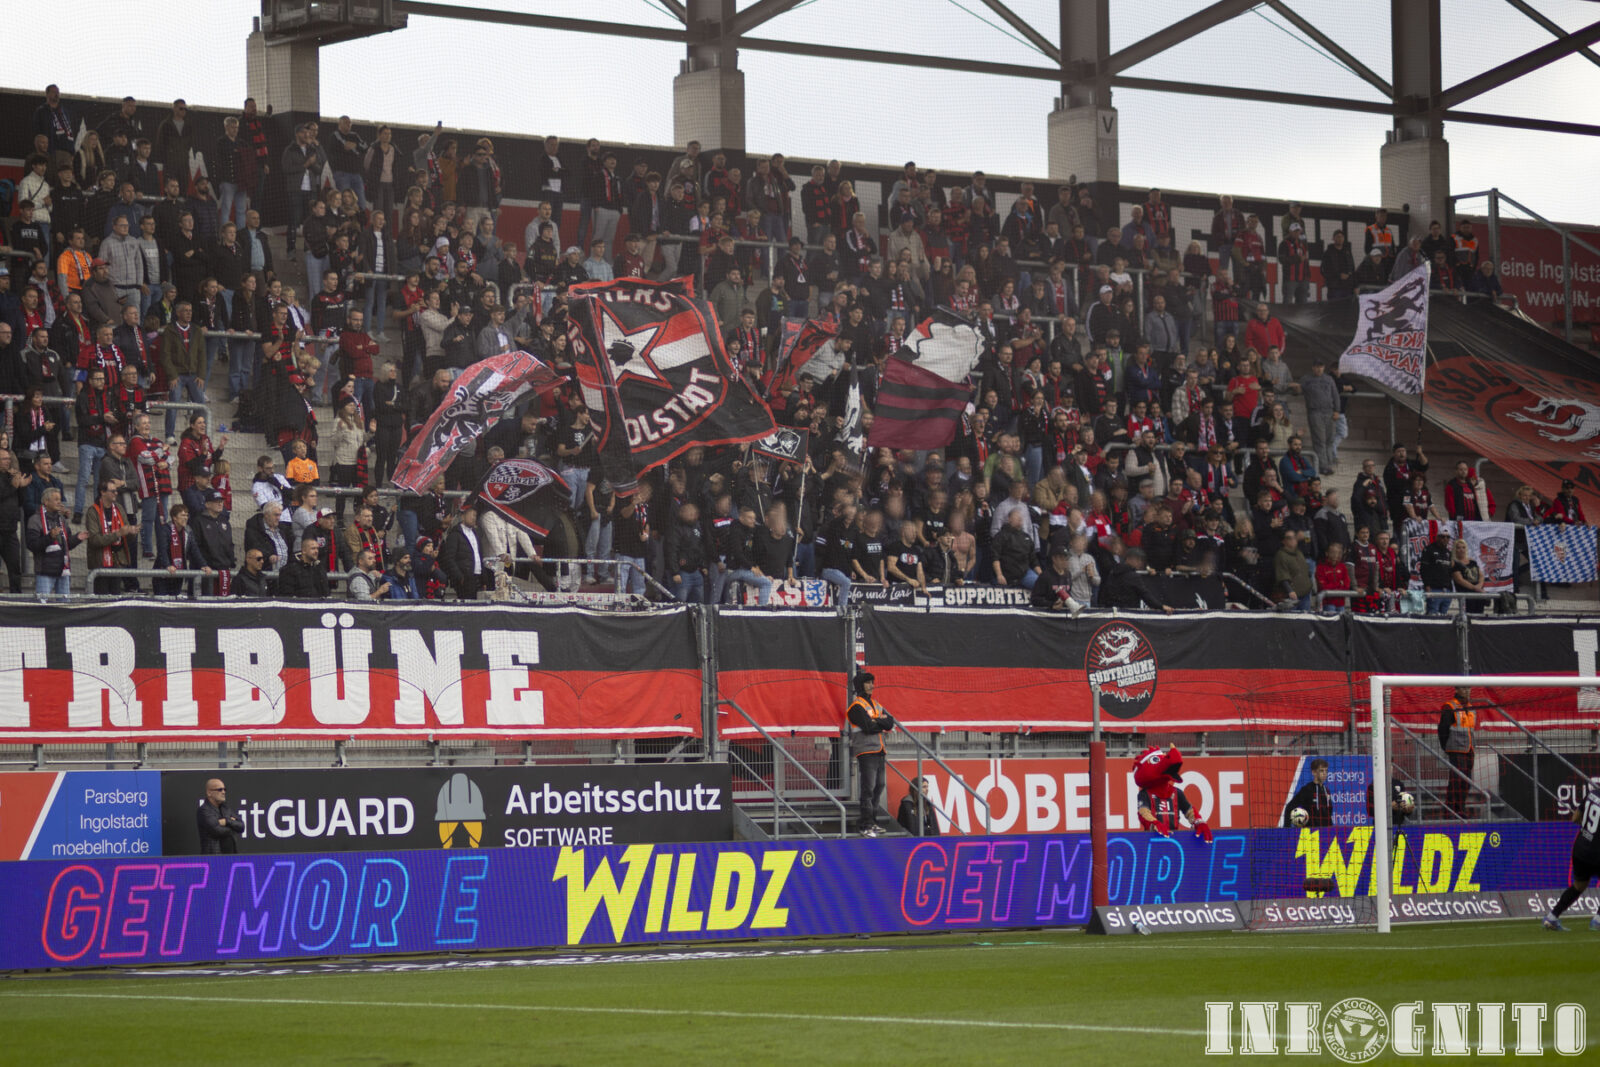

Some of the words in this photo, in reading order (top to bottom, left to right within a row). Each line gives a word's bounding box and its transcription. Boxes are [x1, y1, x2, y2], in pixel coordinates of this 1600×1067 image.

[1327, 768, 1364, 784] arsberg
[85, 788, 148, 807] Parsberg
[505, 781, 721, 815] Arbeitsschutz
[80, 814, 149, 833] Ingolstadt
[52, 837, 149, 856] moebelhof.de
[504, 826, 613, 848] SOFTWARE
[901, 841, 1029, 926] GET
[42, 864, 209, 962] GET
[1265, 902, 1281, 922] si
[1287, 904, 1355, 923] energy
[1401, 895, 1502, 917] electronics
[1528, 893, 1545, 912] si
[1106, 906, 1126, 928] si
[1130, 904, 1236, 927] electronics
